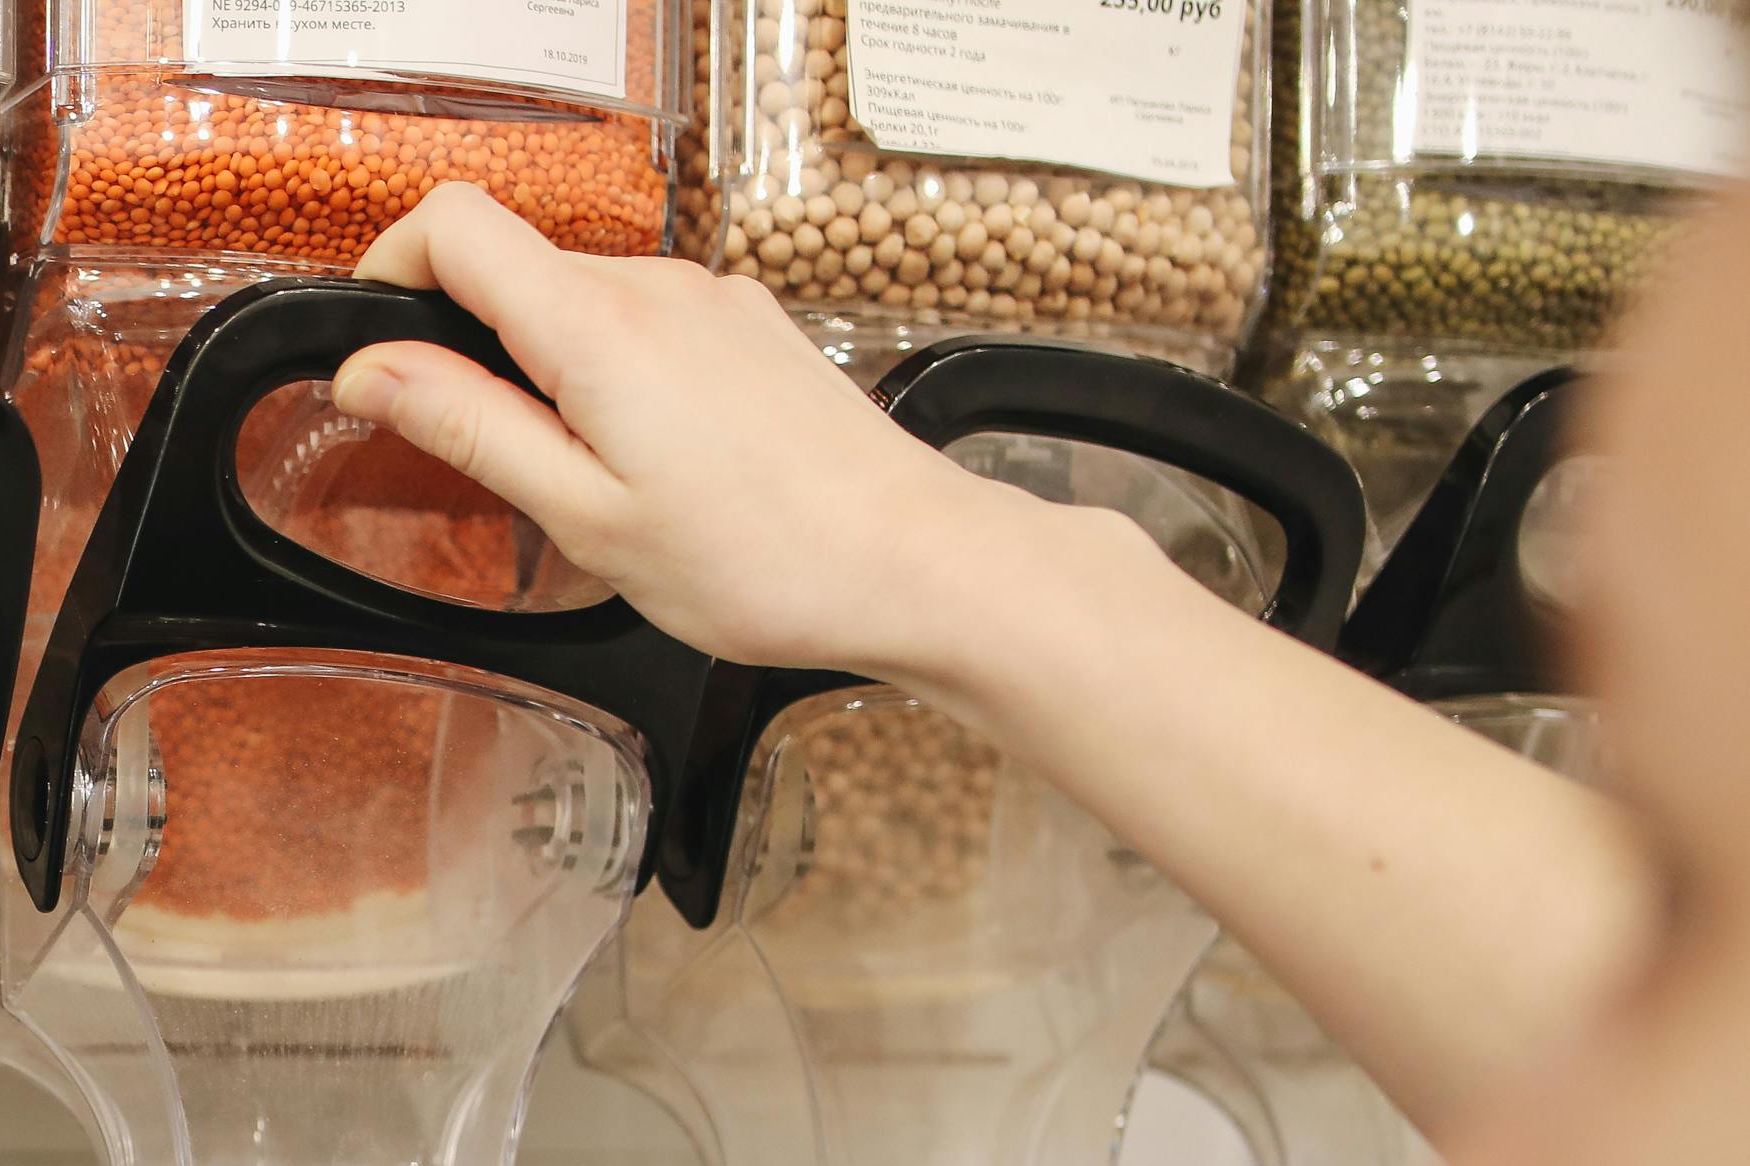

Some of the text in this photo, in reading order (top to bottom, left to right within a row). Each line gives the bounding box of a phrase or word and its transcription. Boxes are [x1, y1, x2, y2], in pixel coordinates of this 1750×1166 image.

[235, 0, 405, 13] 9294-09-46715365-2013
[527, 1, 575, 17] Сергеевна
[859, 1, 974, 25] предварительного
[978, 15, 1059, 34] замачивания
[1179, 0, 1221, 24] руб
[212, 17, 271, 32] Хранить
[289, 20, 328, 33] ухом
[332, 20, 376, 30] месте.
[861, 18, 958, 41] течение 8 часов
[543, 49, 588, 65] 18.10.2019
[860, 34, 987, 63] Срок годности 2 года
[864, 69, 958, 91] Энергетическая
[961, 83, 1016, 100] ценность
[1019, 91, 1033, 101] на
[866, 85, 916, 102] 309кКал
[868, 101, 924, 119] Пищевая
[927, 110, 981, 128] ценность
[983, 120, 998, 130] на
